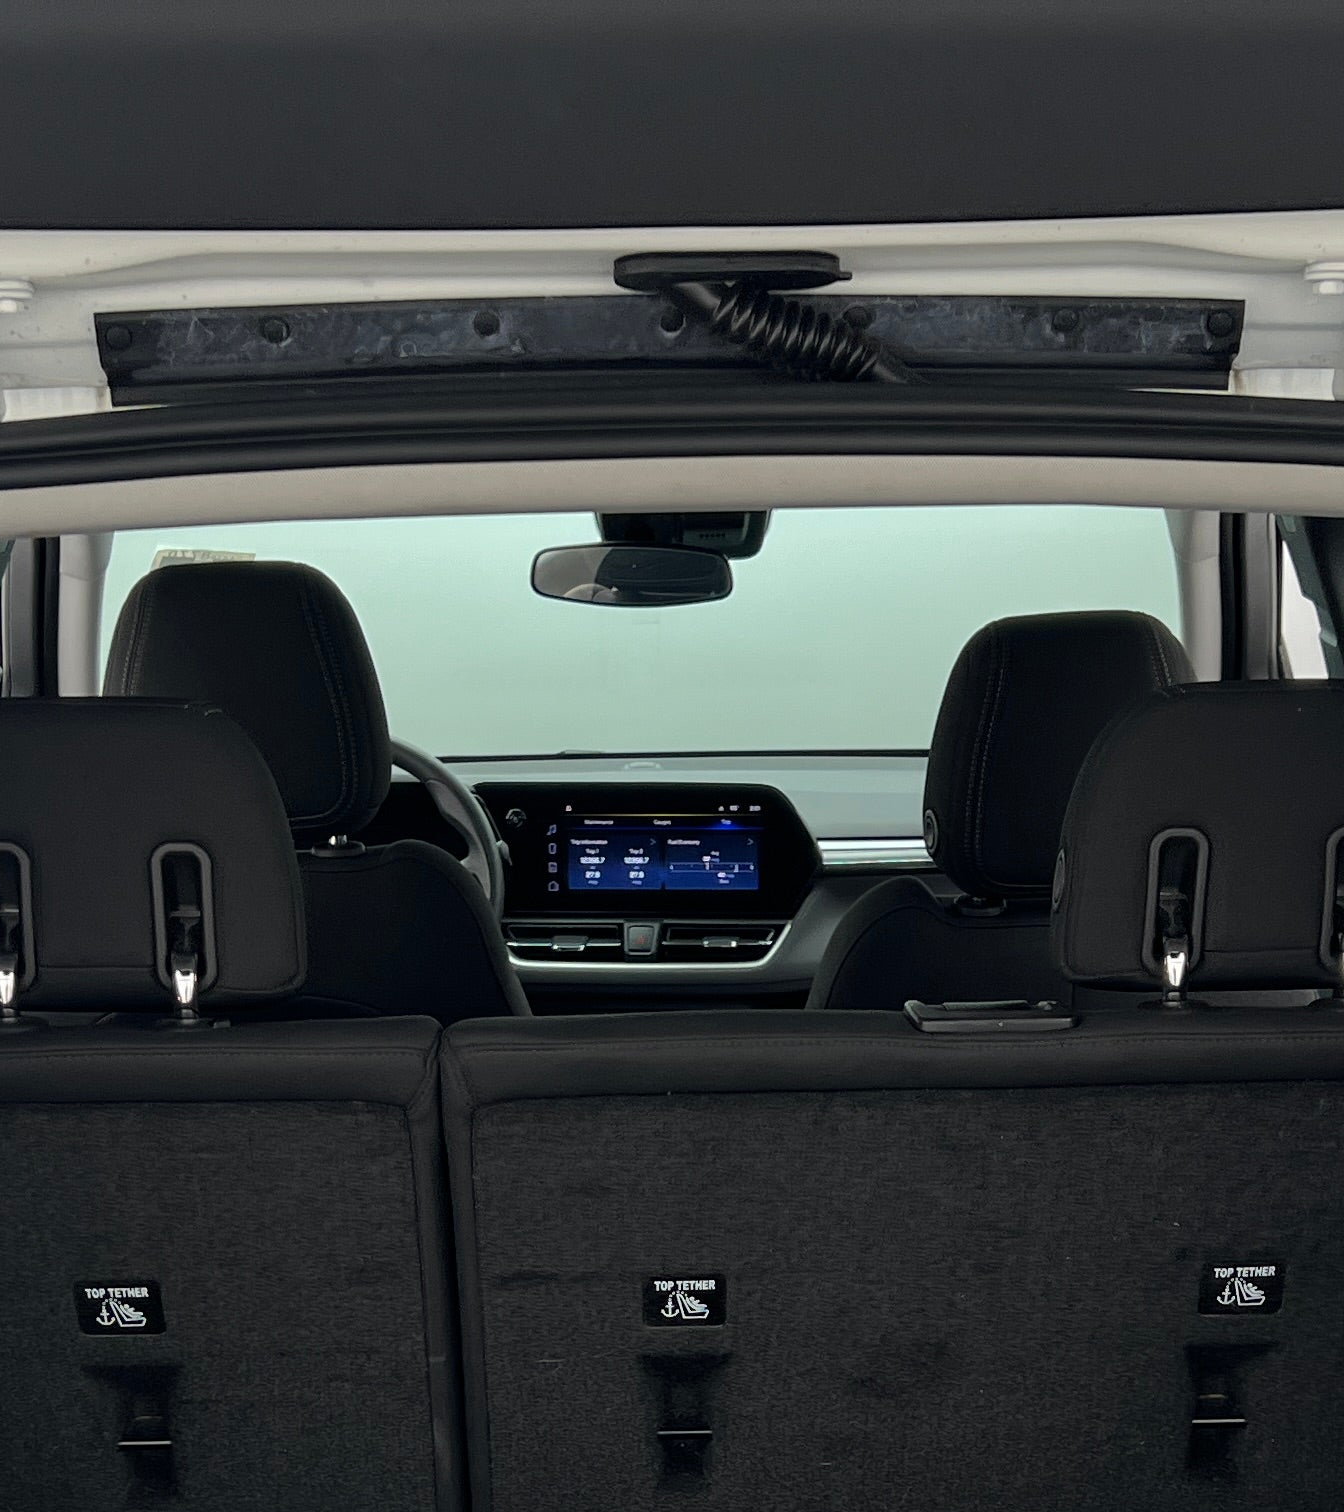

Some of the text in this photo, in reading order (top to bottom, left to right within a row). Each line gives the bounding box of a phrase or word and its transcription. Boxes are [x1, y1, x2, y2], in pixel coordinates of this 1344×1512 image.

[1213, 1265, 1276, 1279] TOP TETHER
[653, 1279, 716, 1292] TOP TETHER
[84, 1286, 150, 1299] TOP TETHER
